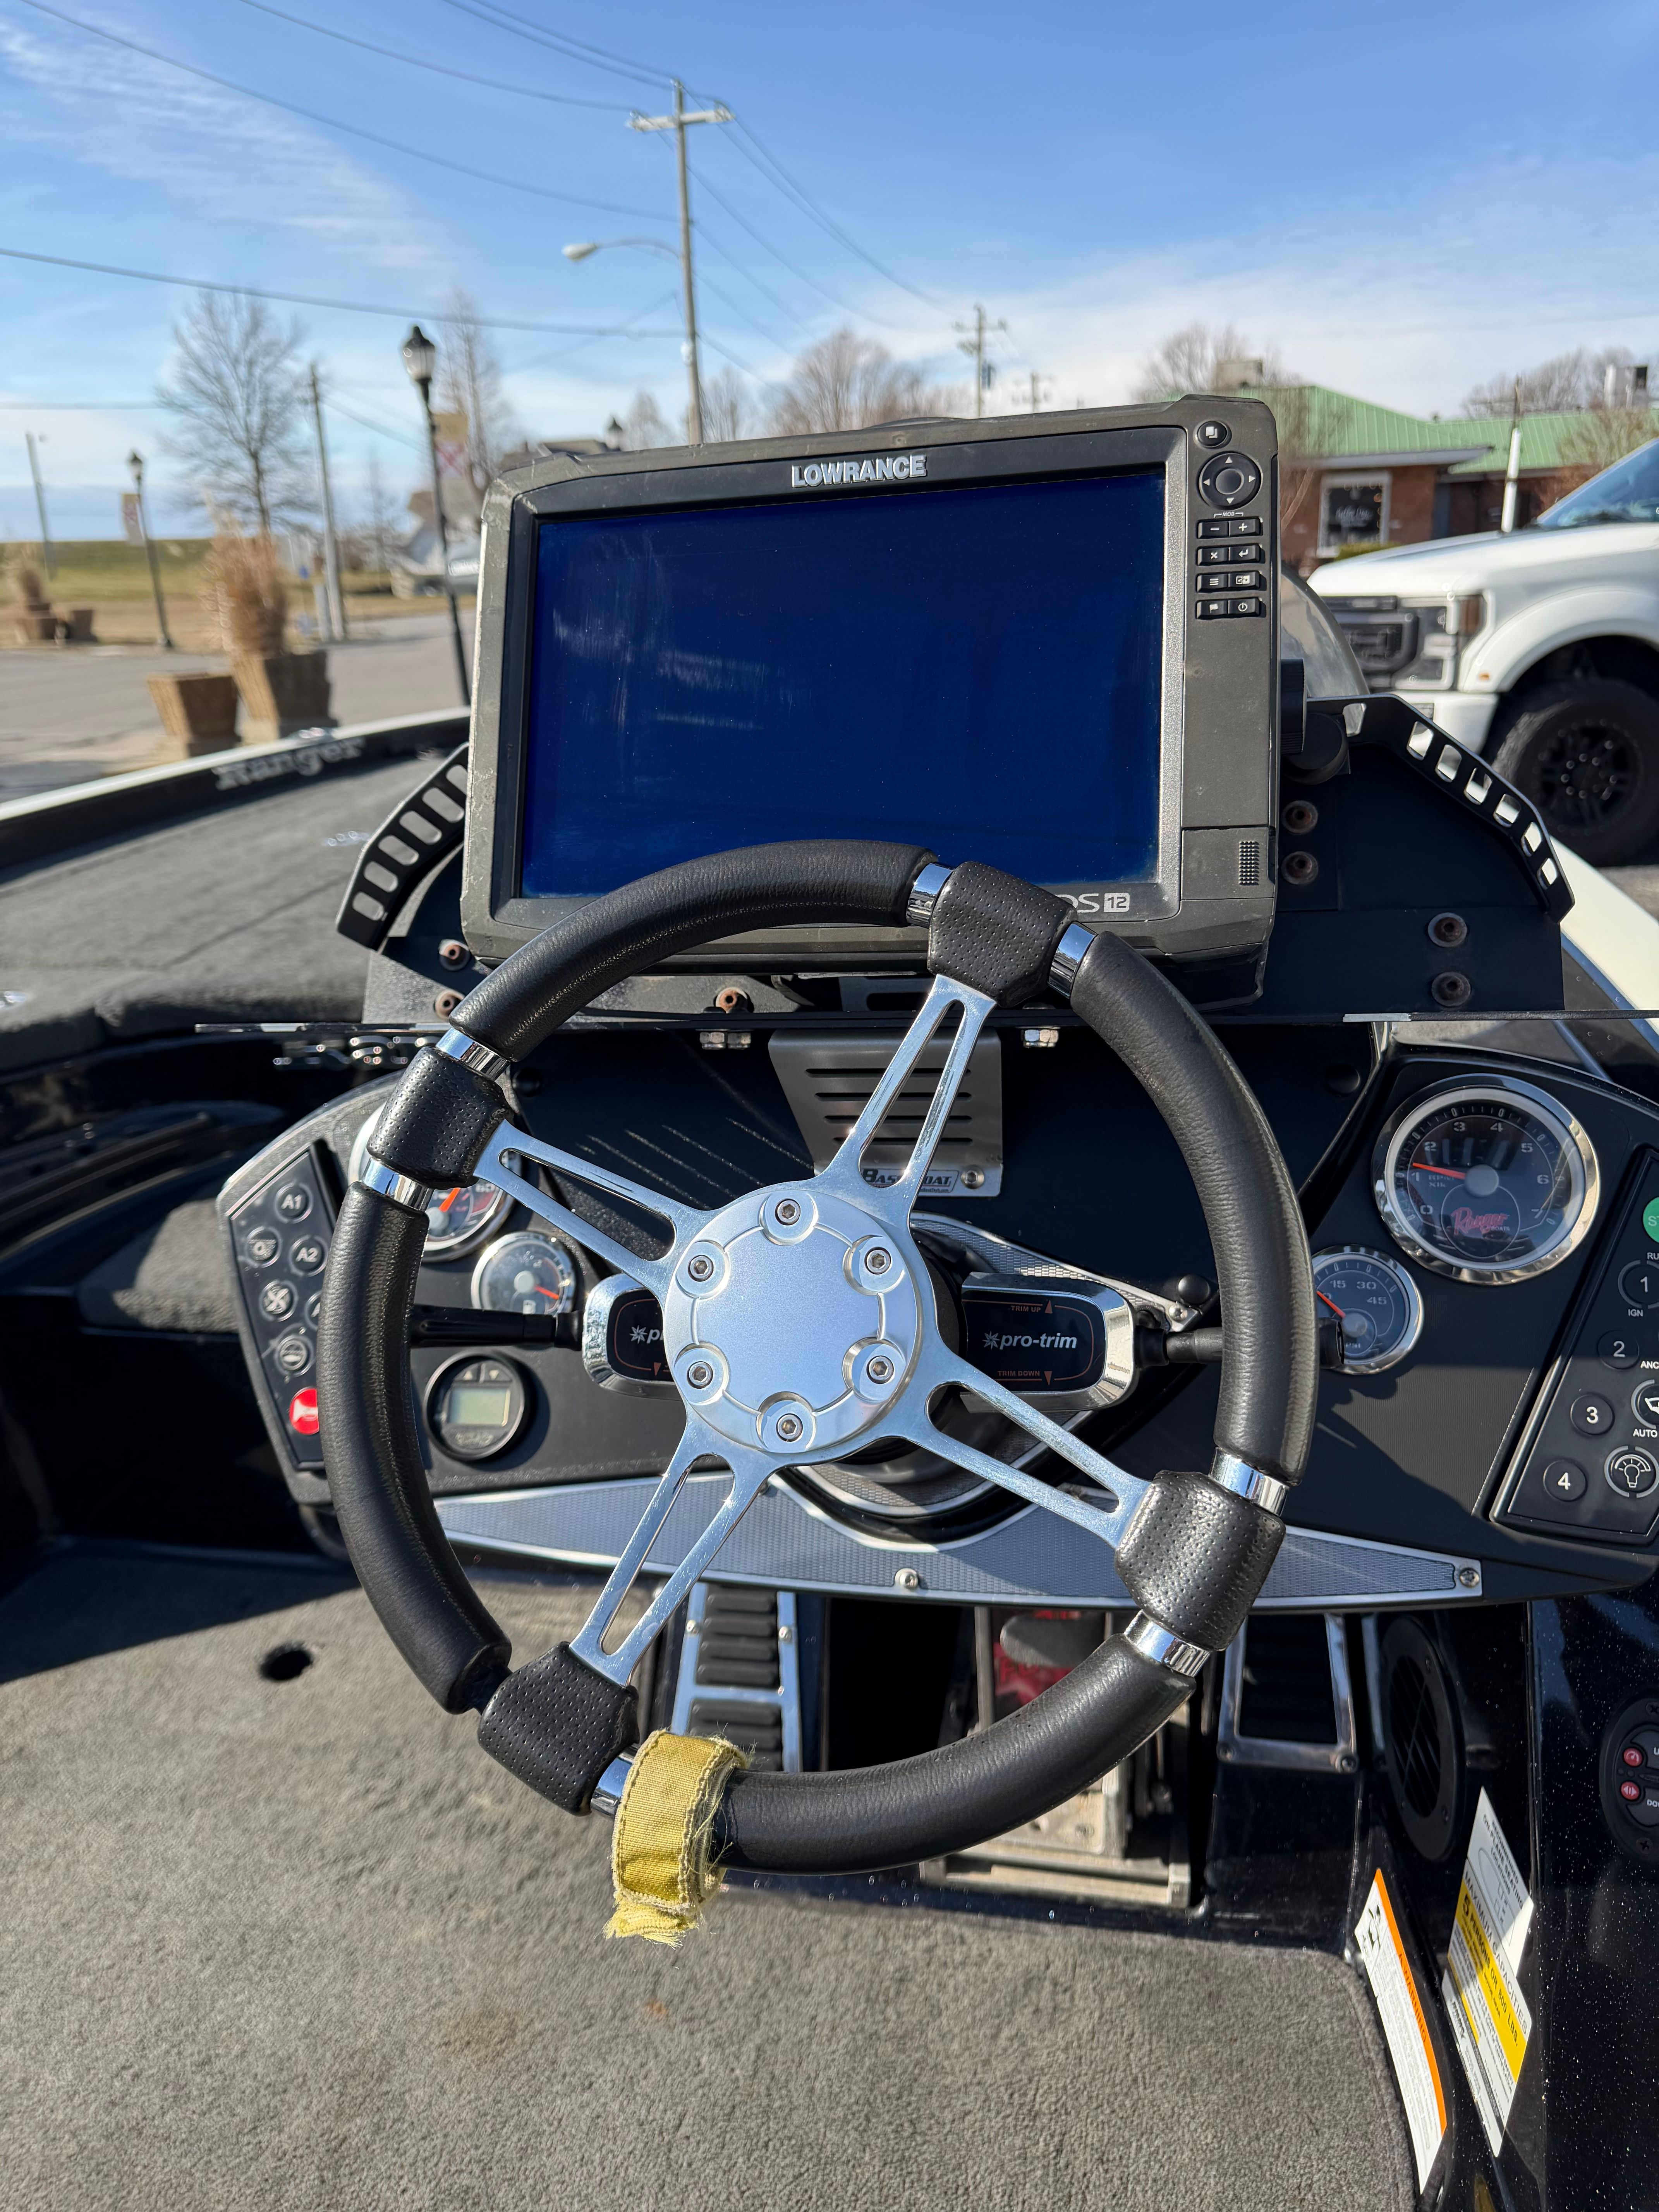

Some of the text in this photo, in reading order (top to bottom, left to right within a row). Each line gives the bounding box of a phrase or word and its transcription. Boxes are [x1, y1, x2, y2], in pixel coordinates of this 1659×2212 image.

[792, 453, 927, 488] LOWRANCE
[1107, 896, 1127, 909] 12
[1453, 1121, 1466, 1132] 3
[1490, 1122, 1503, 1132] 4
[1424, 1141, 1437, 1152] 2
[1521, 1143, 1533, 1153] 5
[1411, 1172, 1419, 1181] 1
[1537, 1175, 1549, 1185] 6
[281, 1194, 302, 1210] A1
[1420, 1205, 1432, 1214] 0
[1531, 1209, 1543, 1219] 7
[1451, 1207, 1508, 1236] Ranger
[295, 1247, 318, 1262] A2
[1329, 1280, 1377, 1290] 15 30
[1640, 1276, 1648, 1293] 1
[1367, 1297, 1387, 1305] 45
[1628, 1309, 1643, 1317] IGN
[1000, 1333, 1078, 1350] pro-trim
[1613, 1340, 1626, 1358] 2
[1586, 1406, 1599, 1424] 3
[1633, 1428, 1658, 1438] AUTO
[1558, 1472, 1570, 1490] 4
[1504, 1863, 1523, 1911] SEATING
[1464, 1869, 1492, 1945] MAXIMUM
[1492, 1939, 1528, 2037] CAPACITIES
[1463, 1893, 1471, 1917] 5
[1470, 1911, 1491, 1971] PERSONS
[1490, 1966, 1498, 1990] OR
[1498, 1987, 1507, 2015] 800
[1507, 2012, 1519, 2048] LBS.
[1403, 1965, 1426, 2043] WARNING
